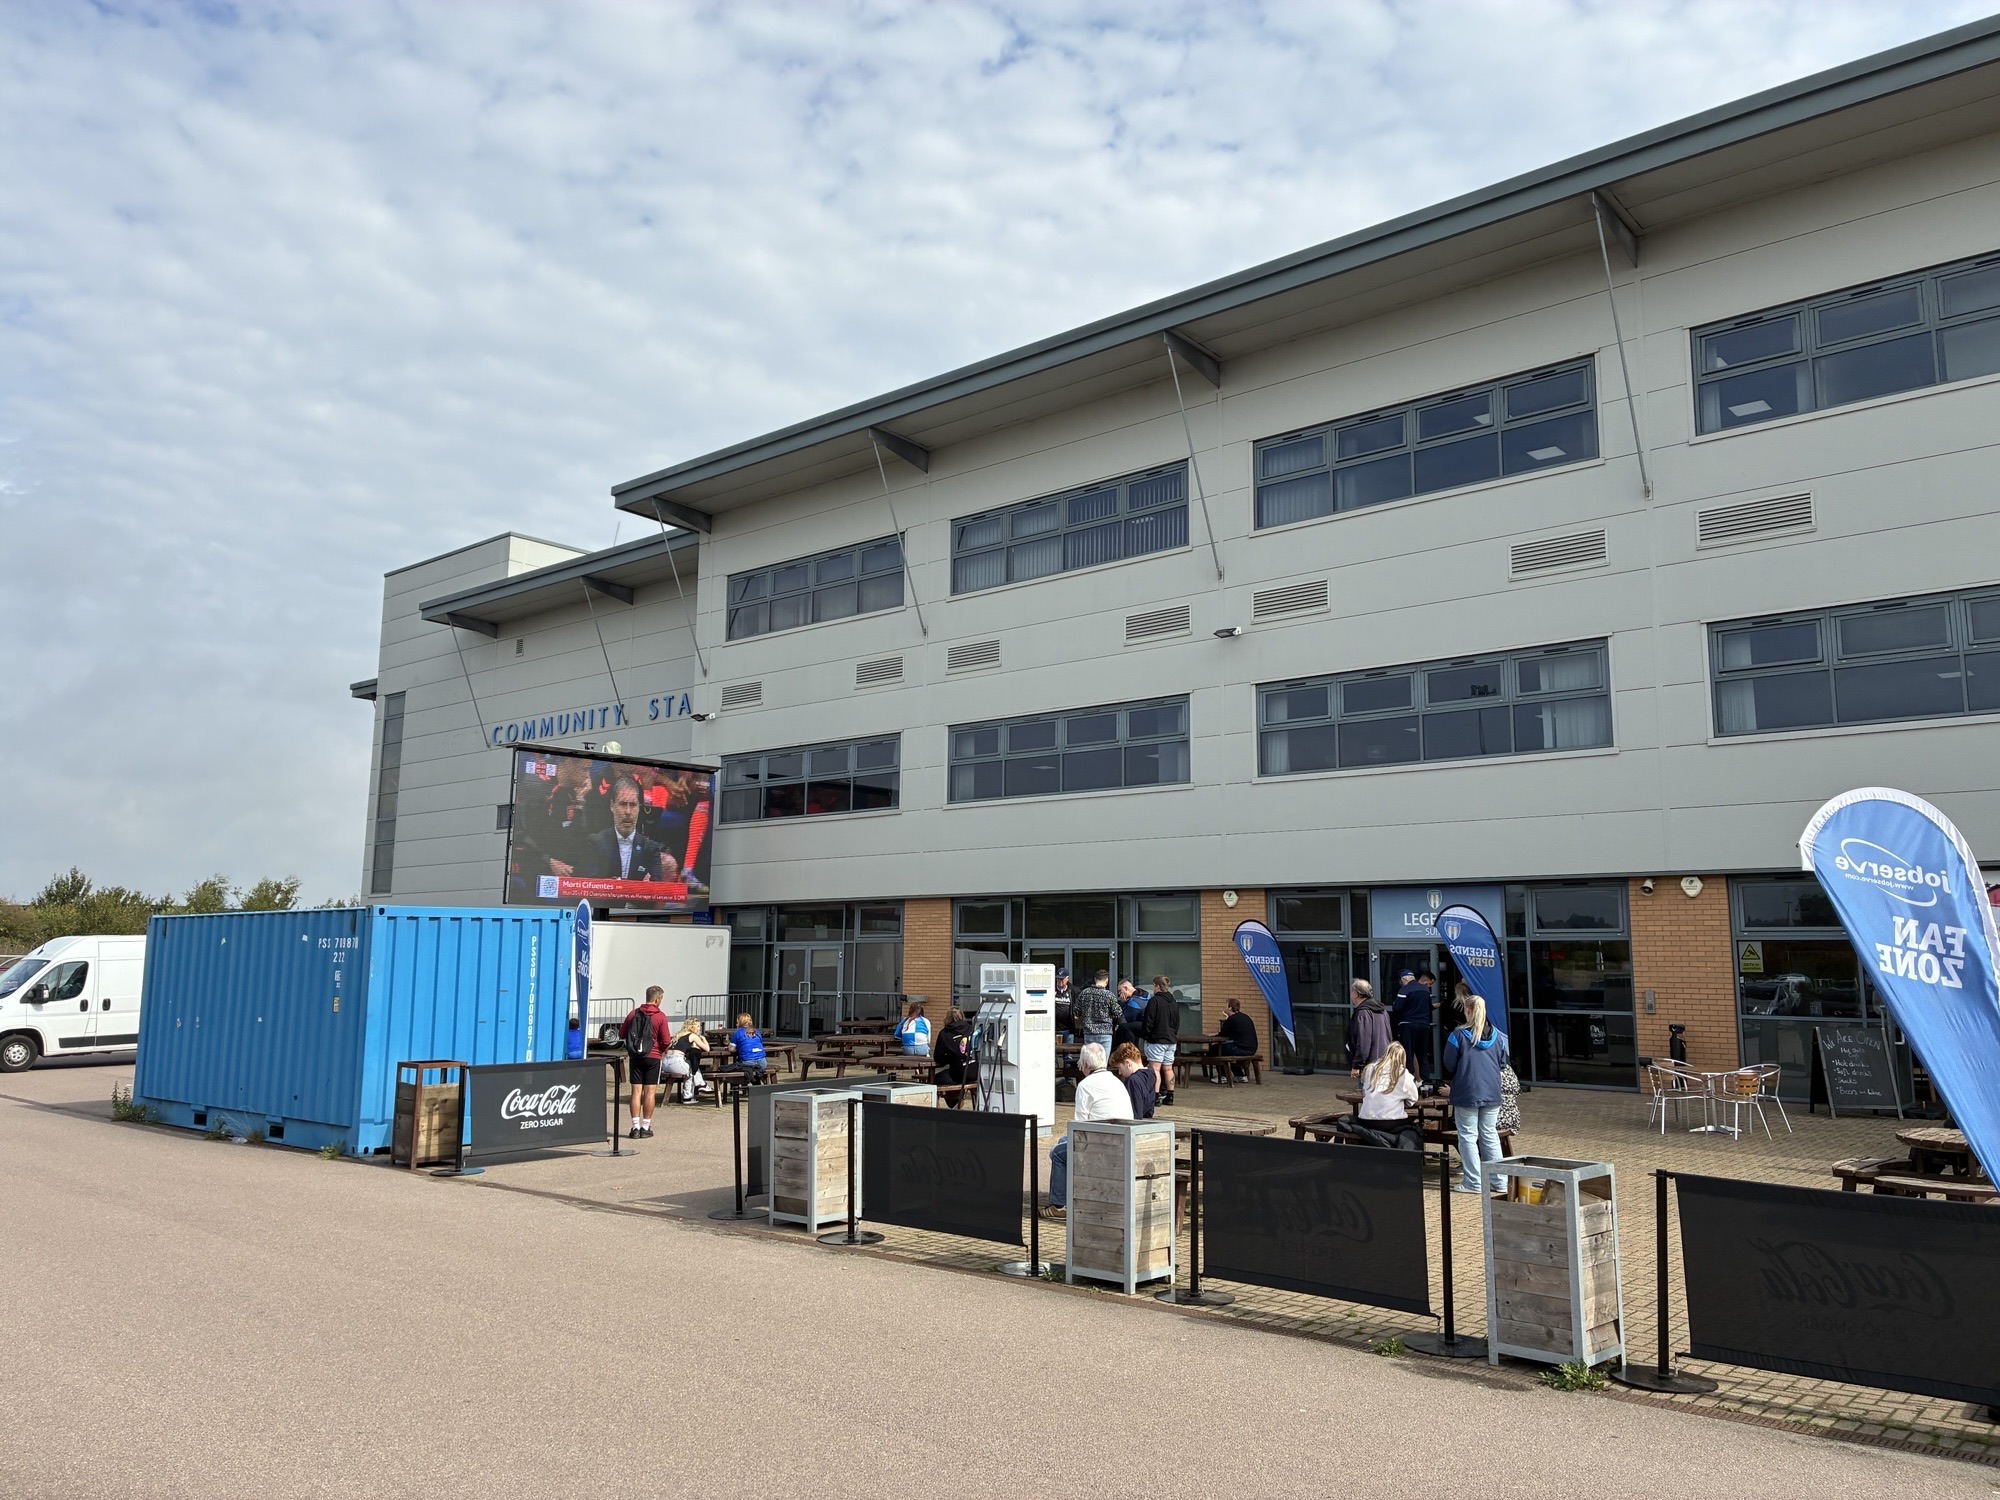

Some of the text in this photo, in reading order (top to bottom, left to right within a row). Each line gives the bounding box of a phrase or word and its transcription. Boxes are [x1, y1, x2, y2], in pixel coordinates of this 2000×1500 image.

[492, 703, 625, 744] COMMUNITY
[1404, 912, 1439, 926] LEGE
[1425, 928, 1440, 936] SUI
[501, 1084, 581, 1119] Coca-Cola
[520, 1118, 563, 1129] ZERO SUGAR
